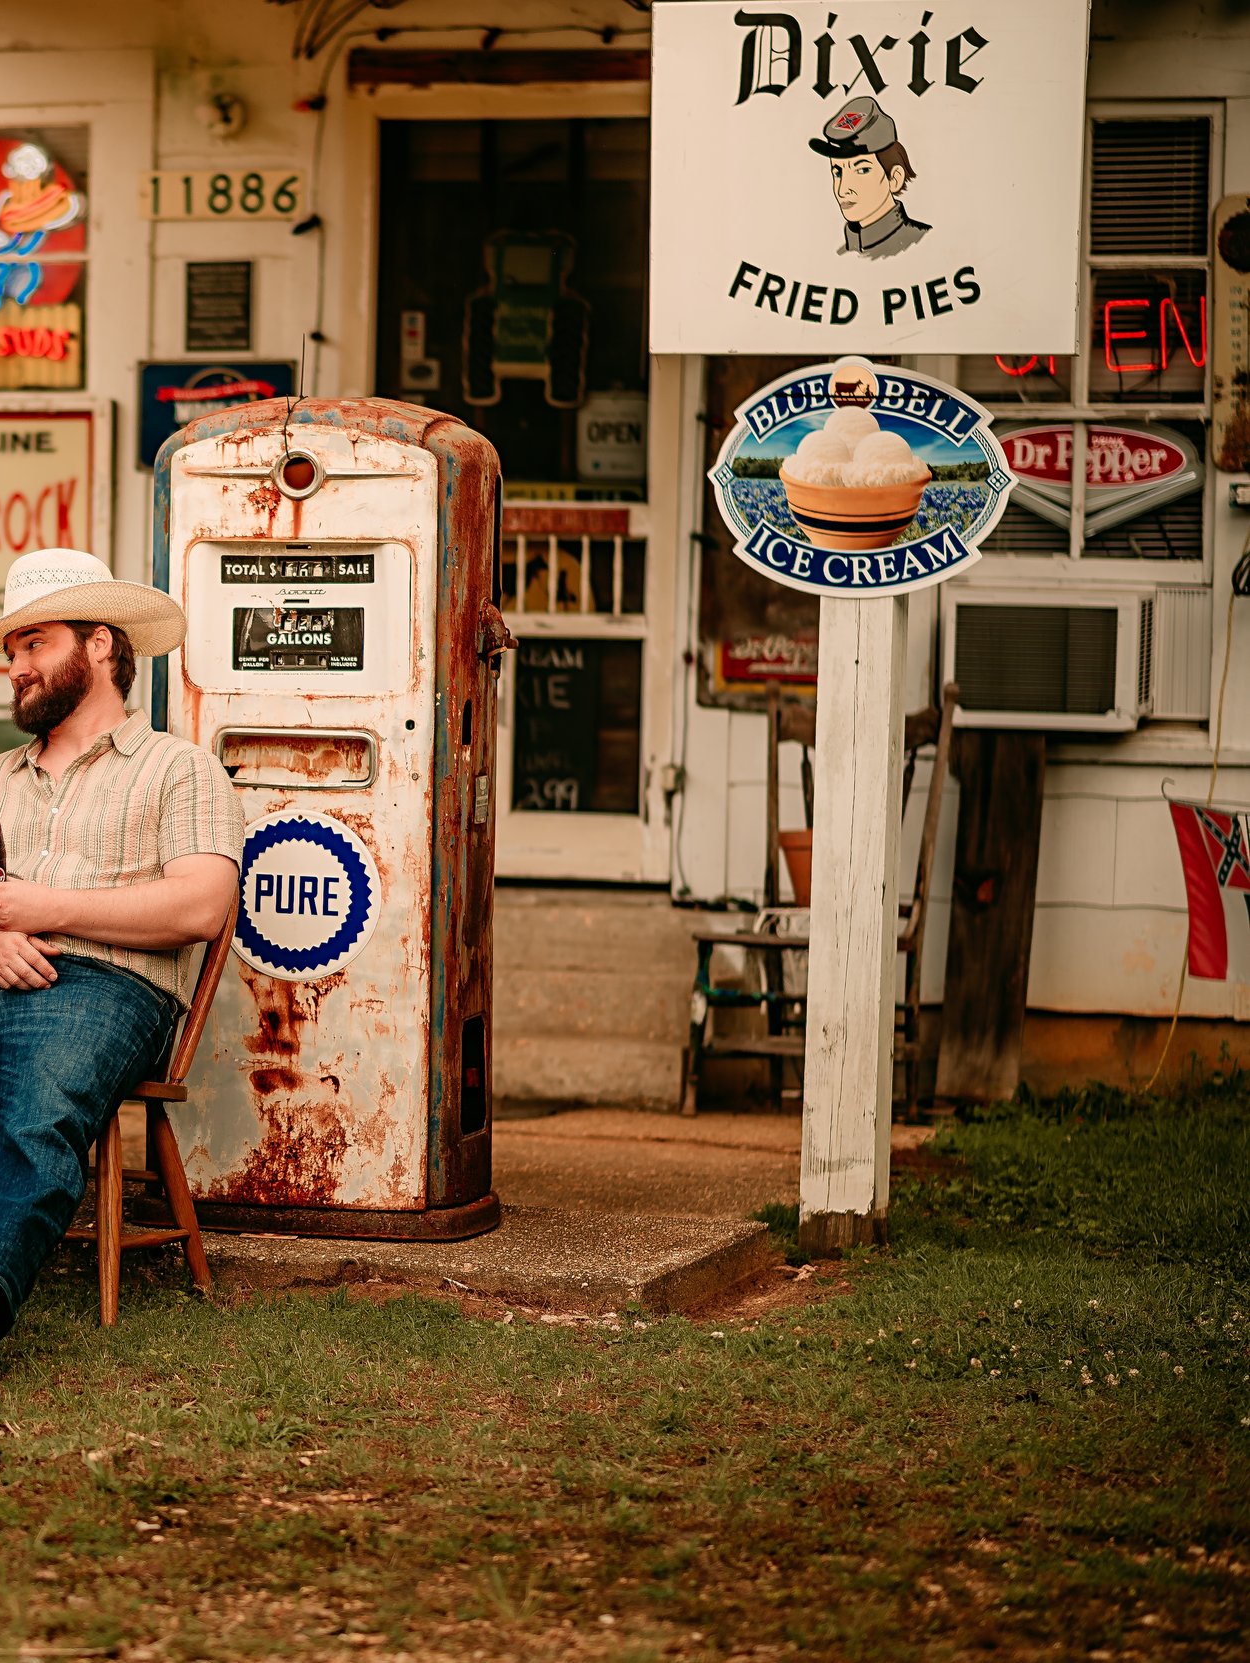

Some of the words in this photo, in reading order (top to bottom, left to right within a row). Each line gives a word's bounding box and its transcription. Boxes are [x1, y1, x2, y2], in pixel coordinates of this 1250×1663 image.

[732, 8, 990, 106] Dixie
[152, 173, 298, 214] 11886
[728, 260, 859, 325] FRIED
[882, 265, 981, 325] PIES
[749, 378, 828, 436] BLUE
[880, 378, 972, 440] BELL
[587, 422, 642, 444] OPEN
[1012, 438, 1052, 469] Dr
[225, 564, 265, 576] TOTAL
[338, 563, 369, 575] SALE
[751, 526, 814, 577] ICE
[823, 531, 963, 584] CREAM
[266, 632, 332, 645] GALLONS
[254, 873, 340, 917] PURE
